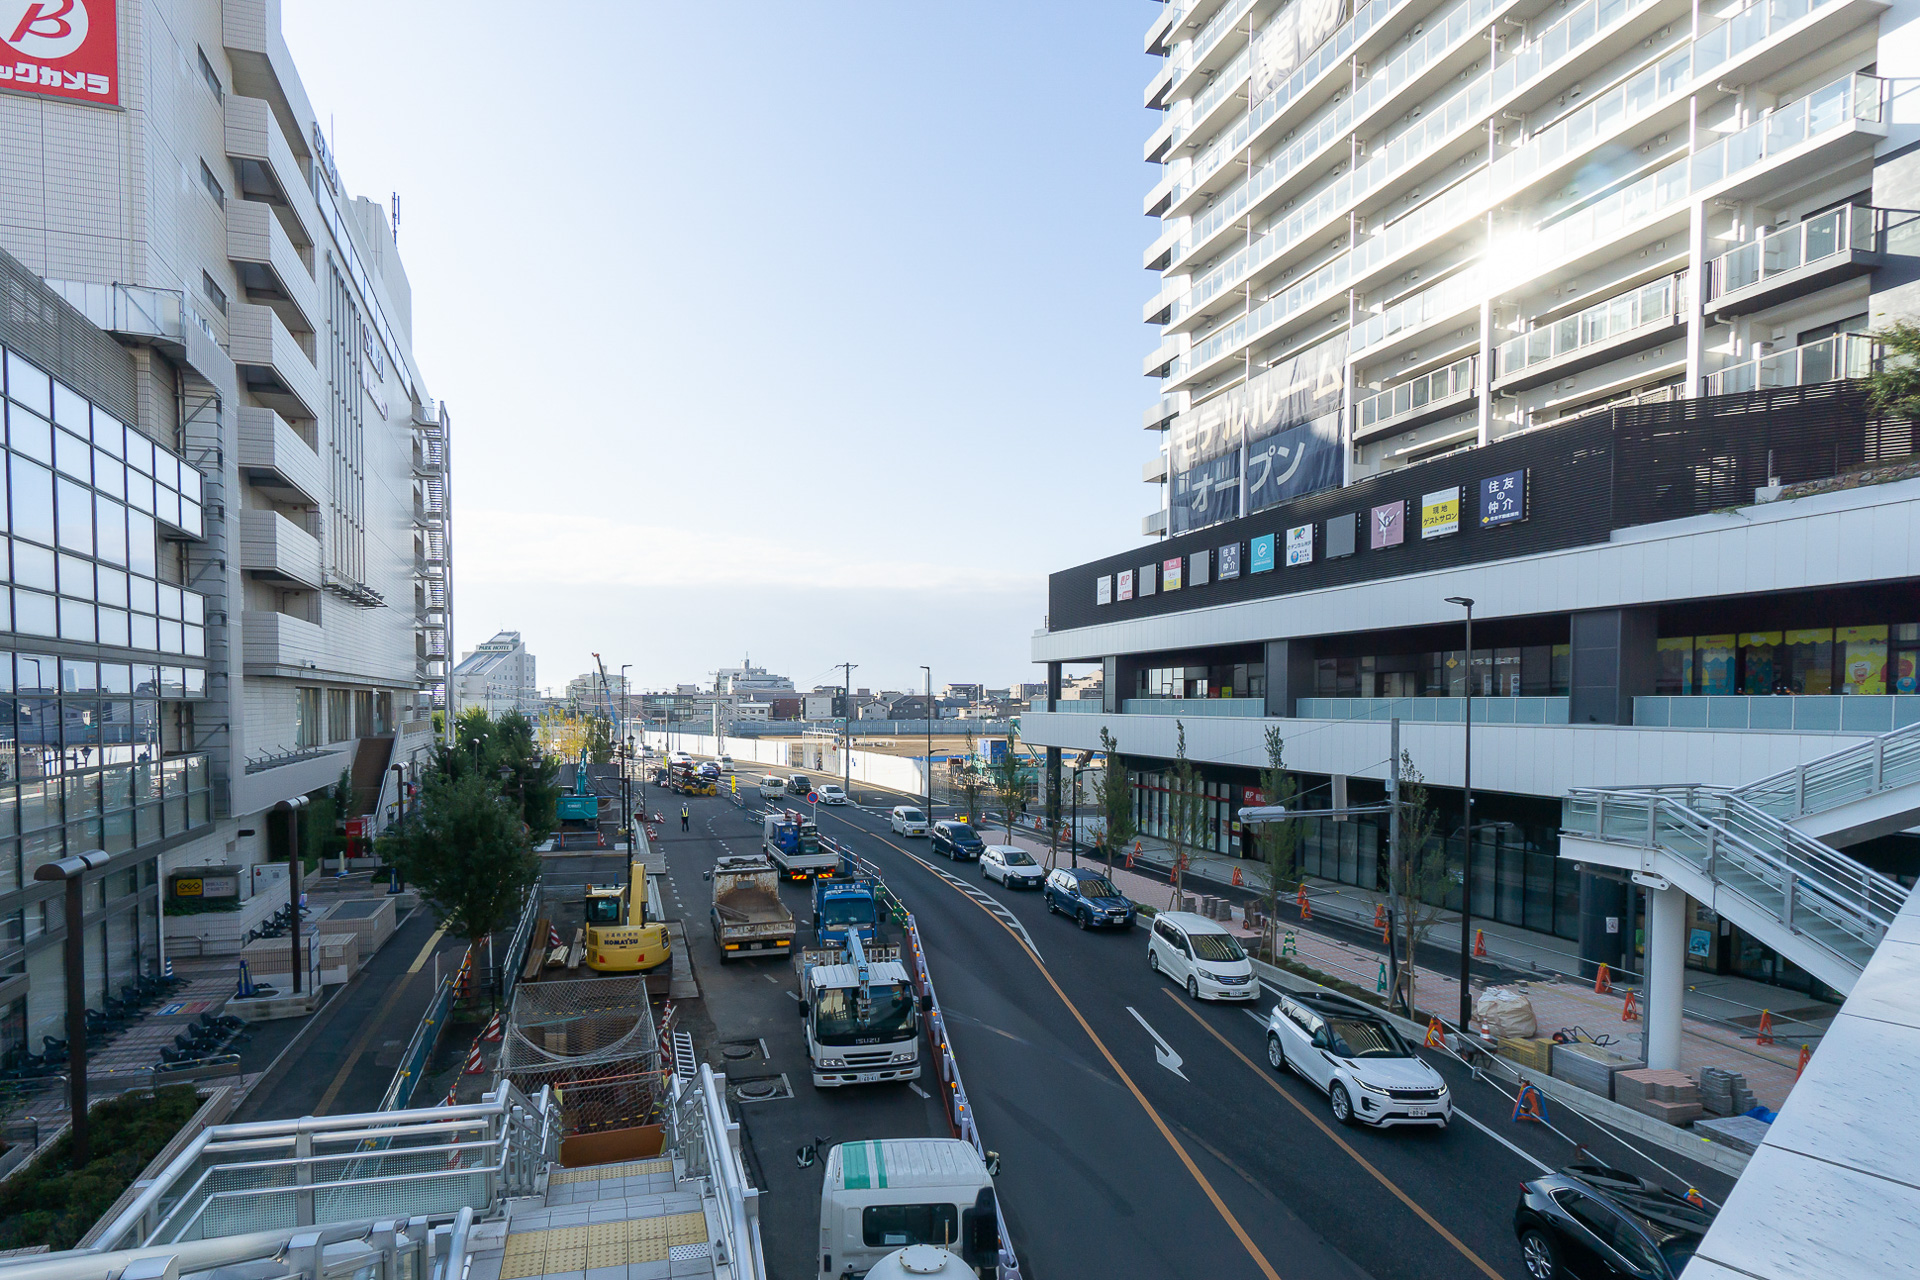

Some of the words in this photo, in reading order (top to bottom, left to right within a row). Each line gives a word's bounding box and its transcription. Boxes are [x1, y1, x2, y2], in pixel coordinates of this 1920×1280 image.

[1175, 353, 1345, 458] モデルルーム
[1190, 442, 1306, 513] オープン
[1488, 477, 1514, 493] 住友
[1496, 491, 1505, 500] の
[1432, 504, 1448, 515] 現地
[1488, 498, 1514, 514] 仲介
[1423, 513, 1458, 526] ゲストサロン
[855, 1037, 880, 1045] ISUZU
